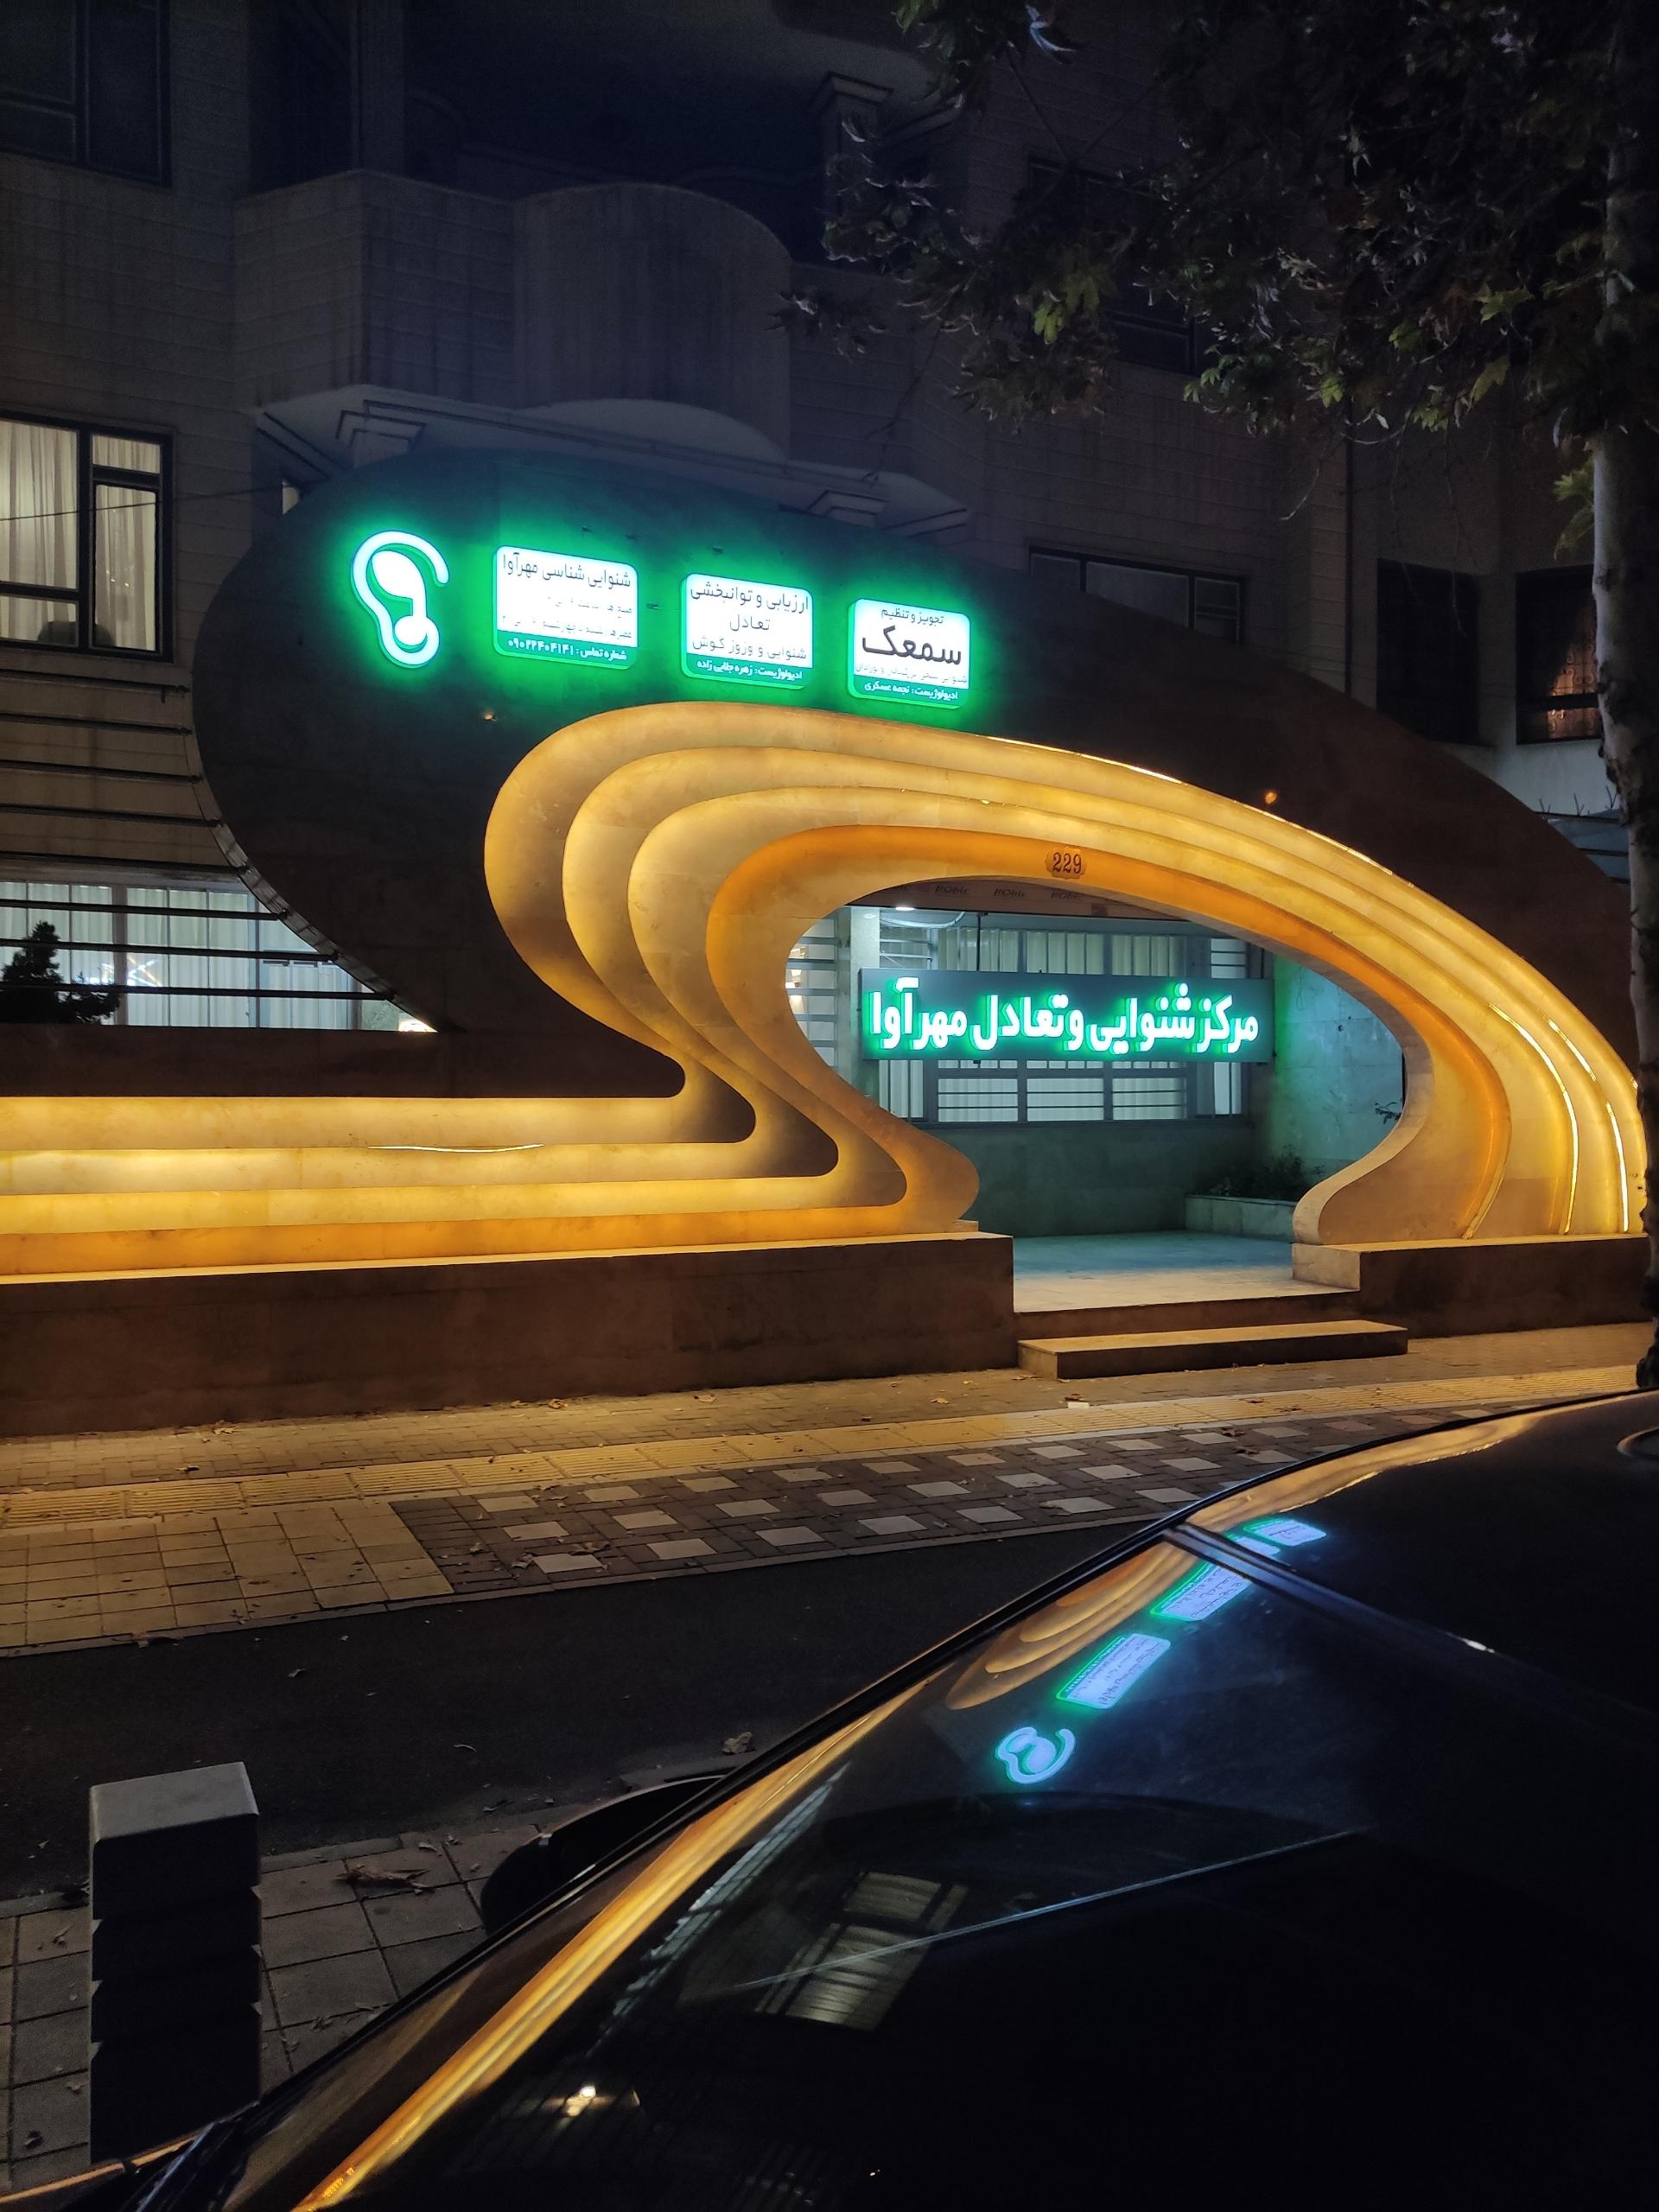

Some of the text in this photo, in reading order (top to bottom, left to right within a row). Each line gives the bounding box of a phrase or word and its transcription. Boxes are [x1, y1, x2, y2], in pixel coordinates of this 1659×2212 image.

[542, 563, 585, 582] شناسی
[588, 569, 631, 590] شنوایی
[690, 582, 809, 614] ارزیابی و توانبخشی
[729, 613, 771, 632] تعادل
[880, 607, 945, 626] تجویز و تنظیم
[604, 648, 627, 662] شماره
[691, 635, 807, 660] شنوایی و وزوز گوش
[861, 625, 962, 665] سمعک
[864, 681, 892, 692] عسکری
[1052, 851, 1082, 874] 229
[971, 993, 1070, 1051] تعادل
[1090, 982, 1196, 1055] شنوایی
[1192, 995, 1260, 1054] مرکز
